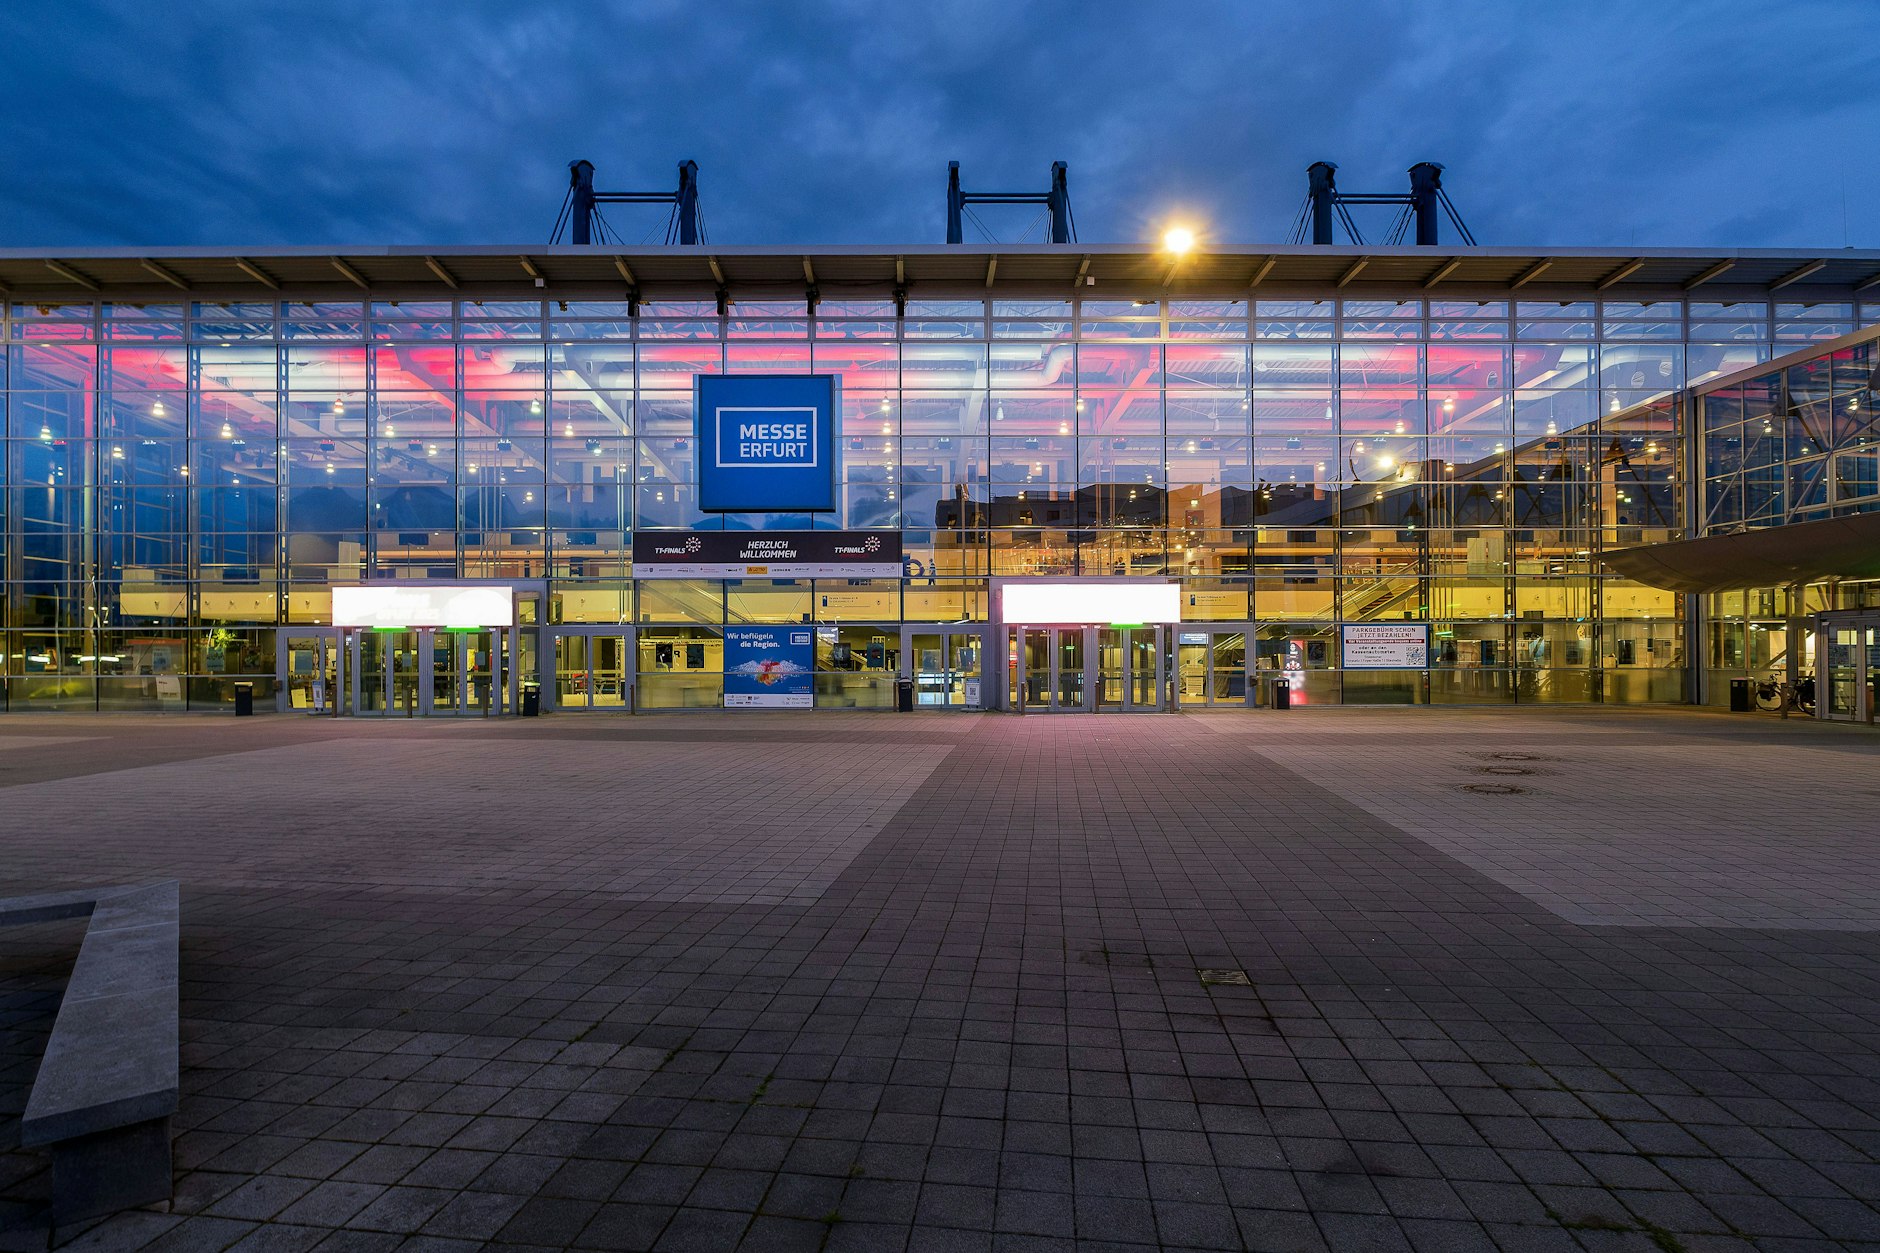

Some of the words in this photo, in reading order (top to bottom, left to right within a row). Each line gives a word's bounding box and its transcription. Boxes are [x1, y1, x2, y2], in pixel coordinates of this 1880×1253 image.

[740, 424, 807, 440] MESSE
[740, 442, 808, 458] ERFURT
[747, 540, 789, 549] HERZLICH
[739, 549, 797, 558] WILLKOMMEN
[834, 546, 866, 554] TT-FINALS
[753, 641, 780, 649] Region.
